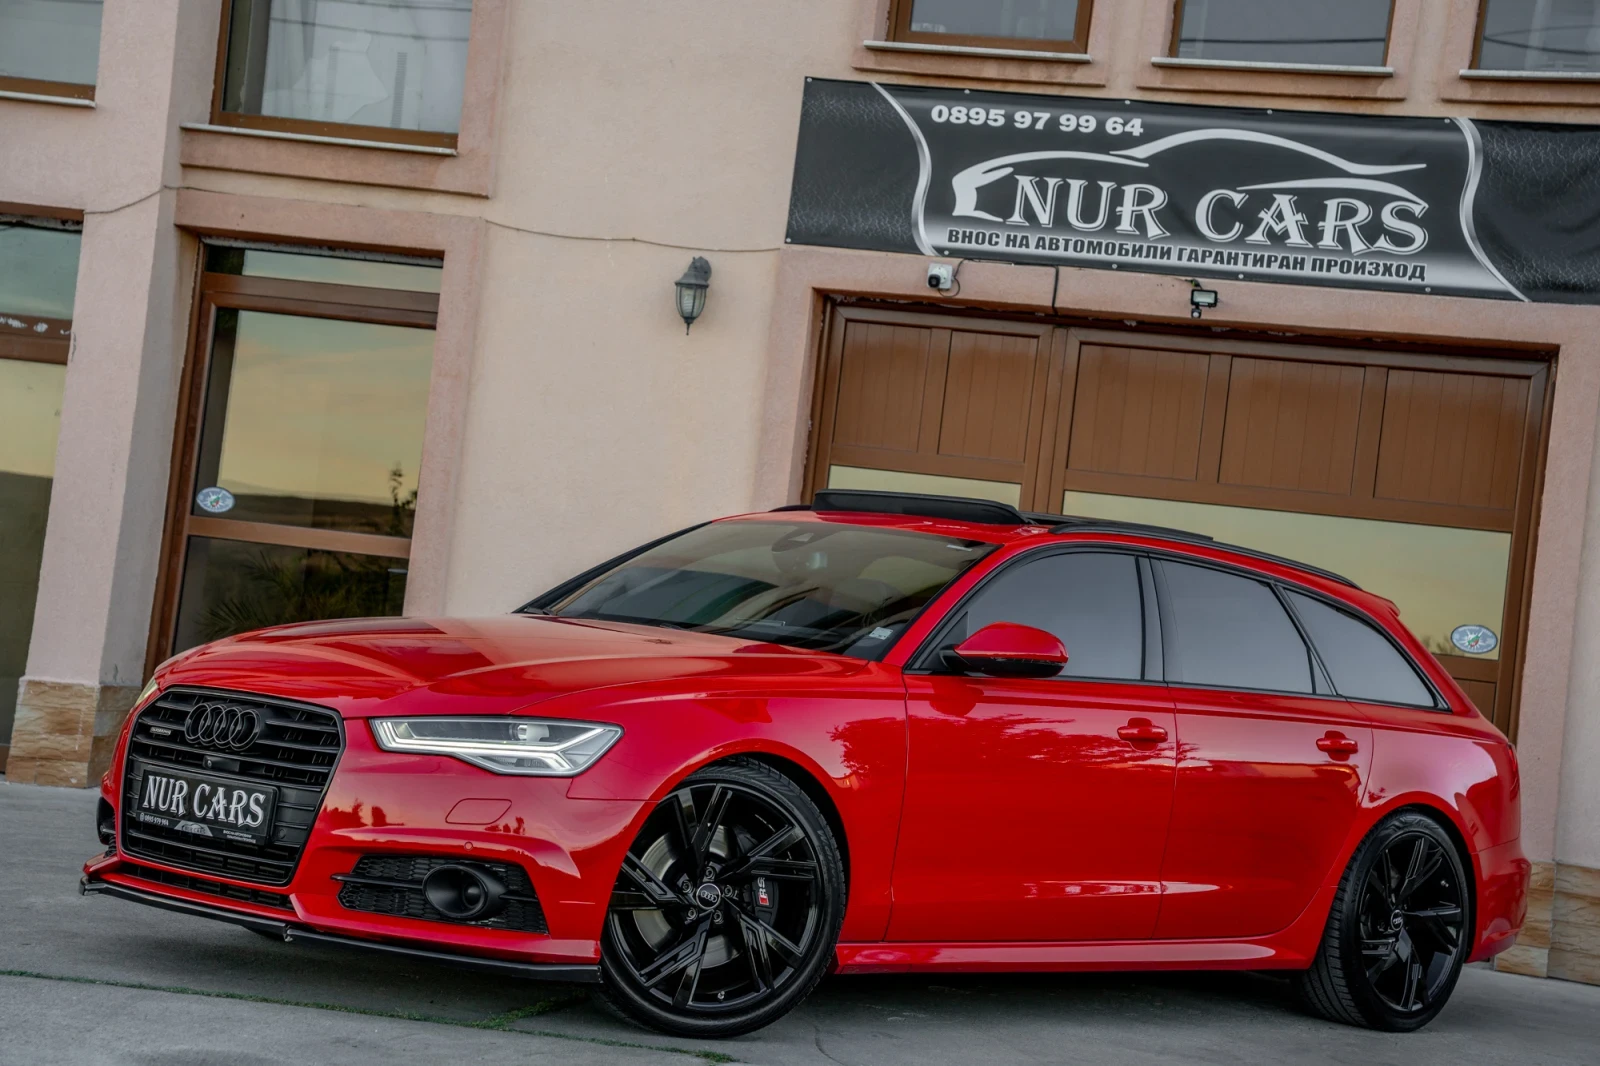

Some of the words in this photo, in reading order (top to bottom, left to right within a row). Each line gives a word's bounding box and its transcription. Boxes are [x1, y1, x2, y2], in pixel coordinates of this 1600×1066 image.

[931, 105, 1005, 127] 0895
[1014, 111, 1051, 130] 97
[1059, 114, 1097, 133] 99
[1105, 117, 1144, 136] 64
[1005, 174, 1171, 240] NUR
[1195, 189, 1429, 256] CARS
[947, 229, 1000, 246] ВНОС
[1005, 233, 1031, 249] НА
[1034, 235, 1173, 261] АВТОМОБИЛИ
[1177, 247, 1305, 271] ГАРАНТИРАН
[1310, 257, 1427, 282] ПРОИЗХОД
[142, 775, 188, 817] NUR
[193, 783, 266, 828] CARS
